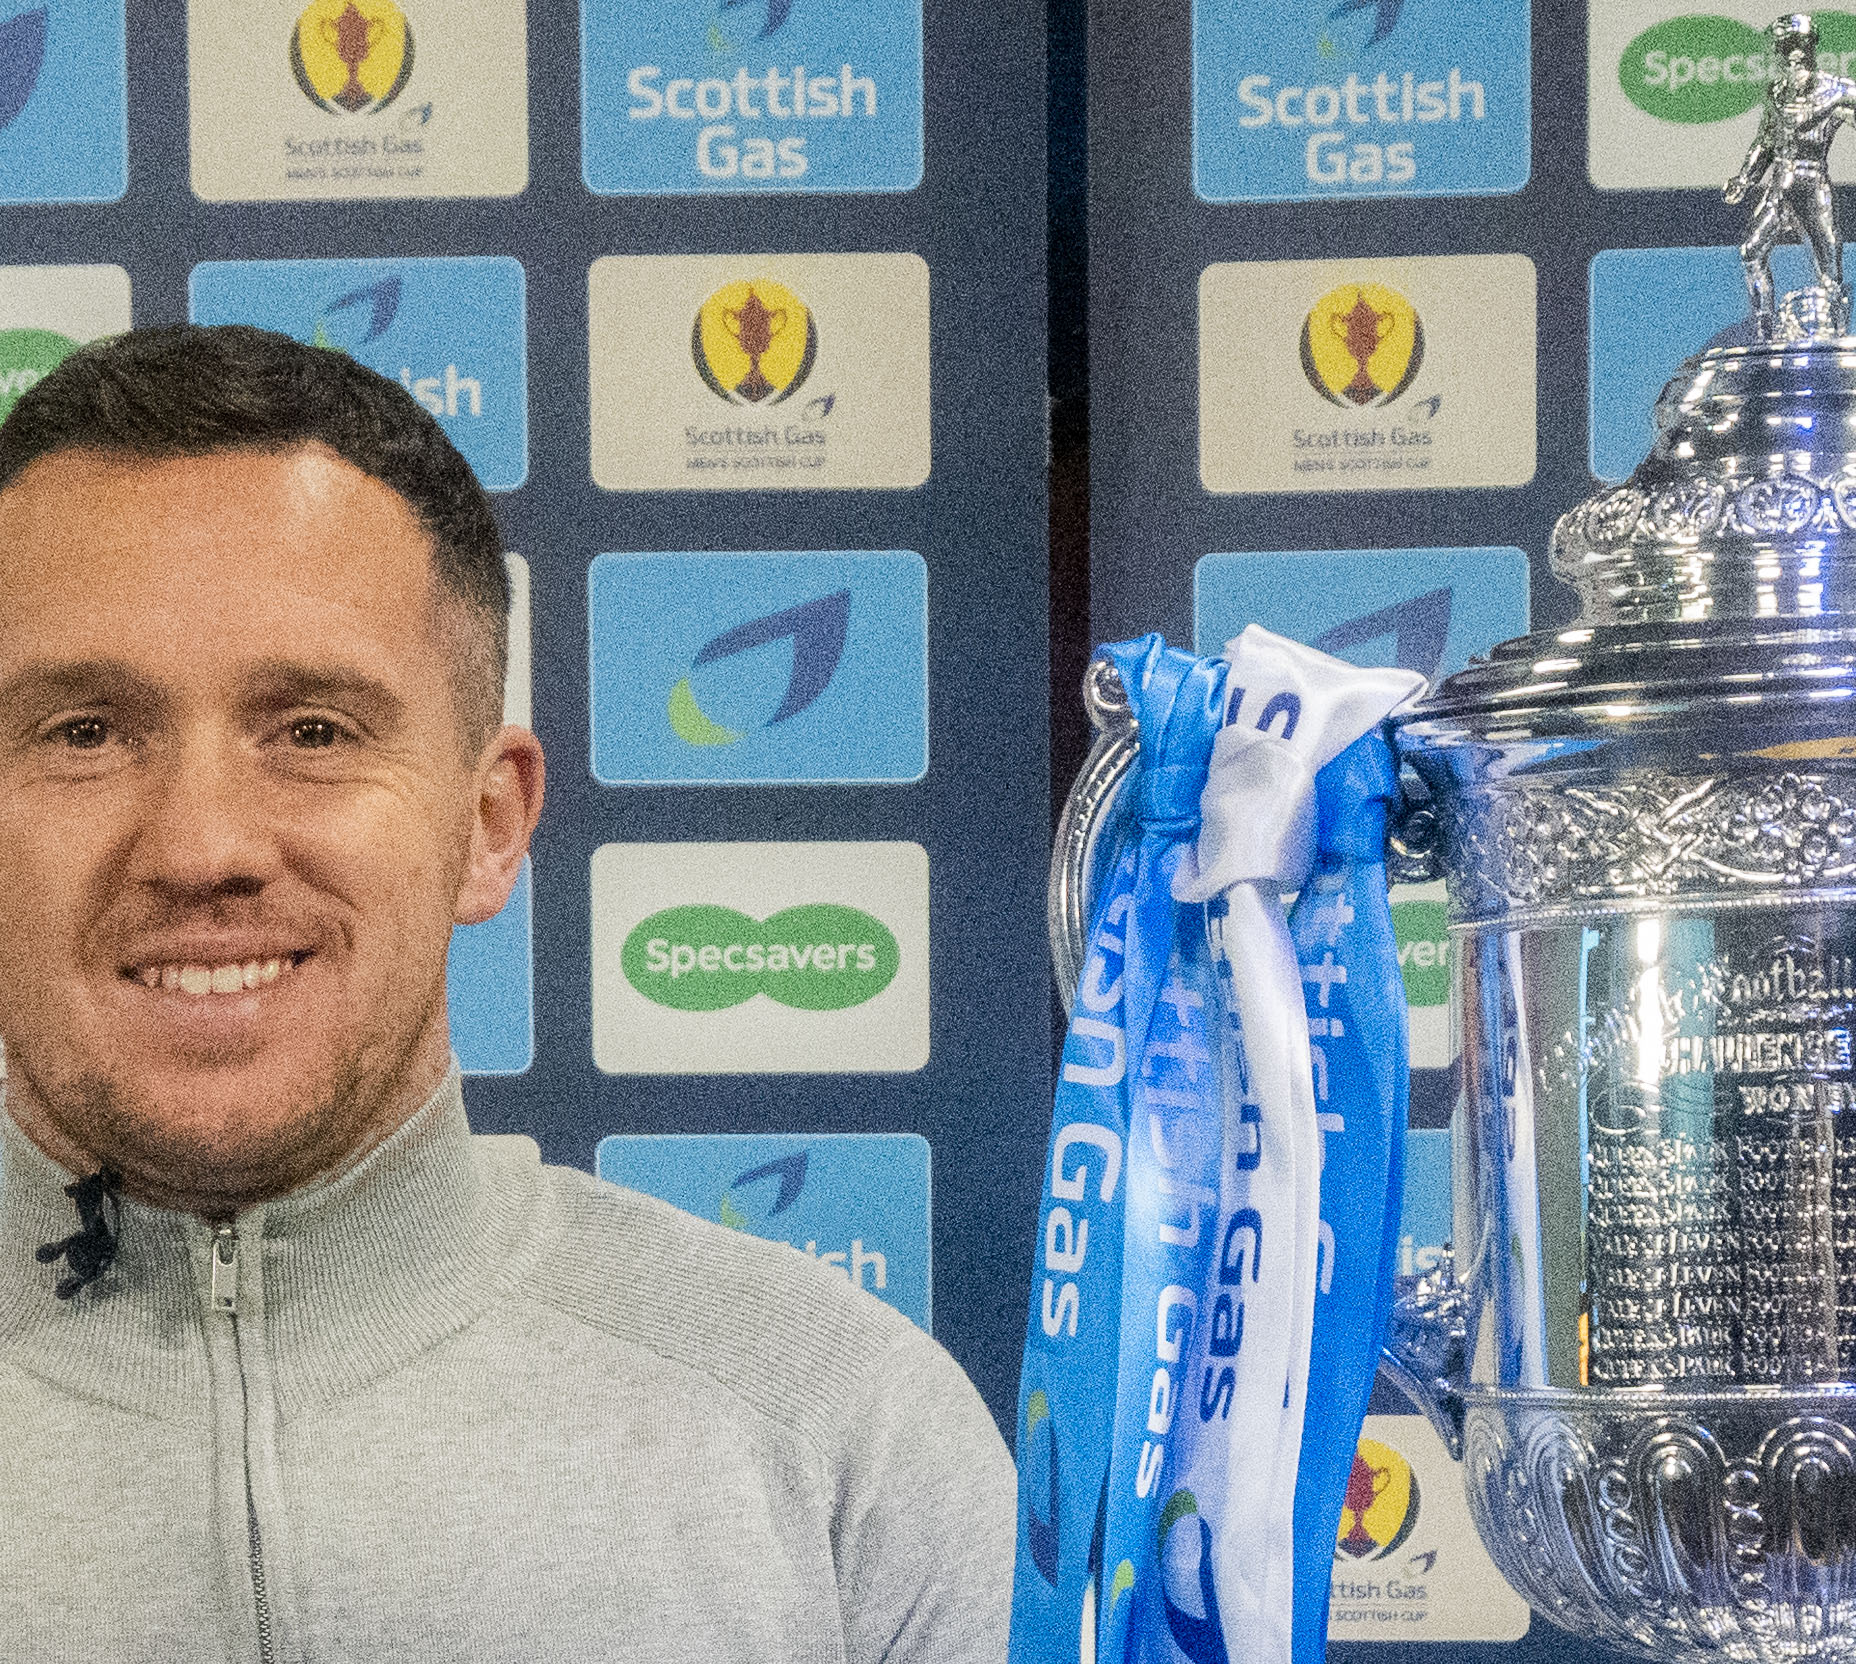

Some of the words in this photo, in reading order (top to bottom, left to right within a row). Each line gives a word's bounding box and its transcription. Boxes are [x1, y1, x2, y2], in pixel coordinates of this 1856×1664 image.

[627, 64, 876, 120] Scottish
[1238, 69, 1485, 129] Scottish
[284, 137, 377, 158] Scottish
[382, 136, 424, 157] Gas
[696, 124, 808, 180] Gas
[1304, 130, 1416, 185] Gas
[685, 428, 779, 447] Scottish
[784, 428, 827, 447] Gas
[1291, 430, 1385, 449] Scottish
[1390, 429, 1432, 447] Gas
[645, 937, 877, 980] Specsavers
[1043, 1123, 1122, 1340] Gas
[1199, 1205, 1263, 1425] Gas
[1135, 1282, 1198, 1499] Gas
[1386, 1579, 1428, 1600] Gas
